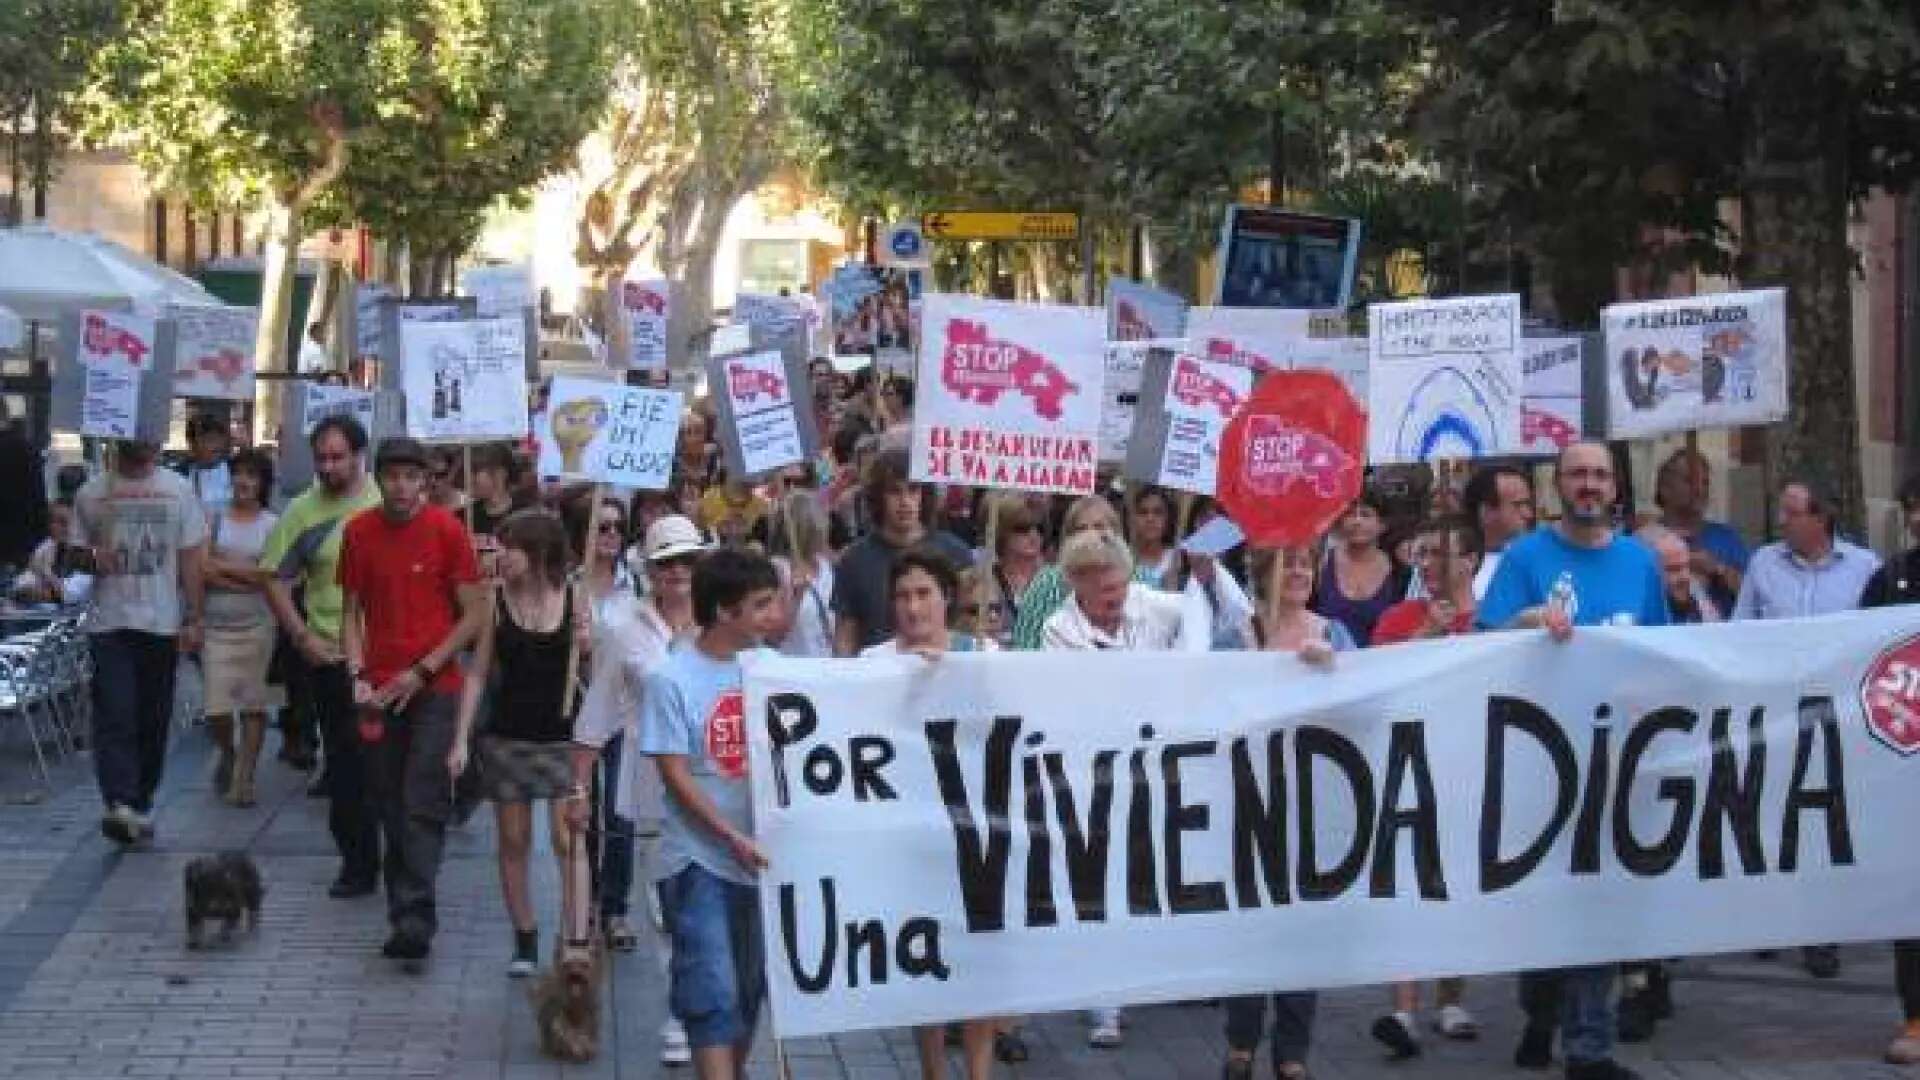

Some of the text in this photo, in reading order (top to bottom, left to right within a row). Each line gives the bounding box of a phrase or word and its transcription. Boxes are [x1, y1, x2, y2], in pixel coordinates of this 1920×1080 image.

[952, 343, 1019, 371] STOP
[1253, 434, 1304, 462] STOP
[962, 454, 988, 481] VA
[713, 714, 744, 743] ST
[780, 877, 950, 993] Una
